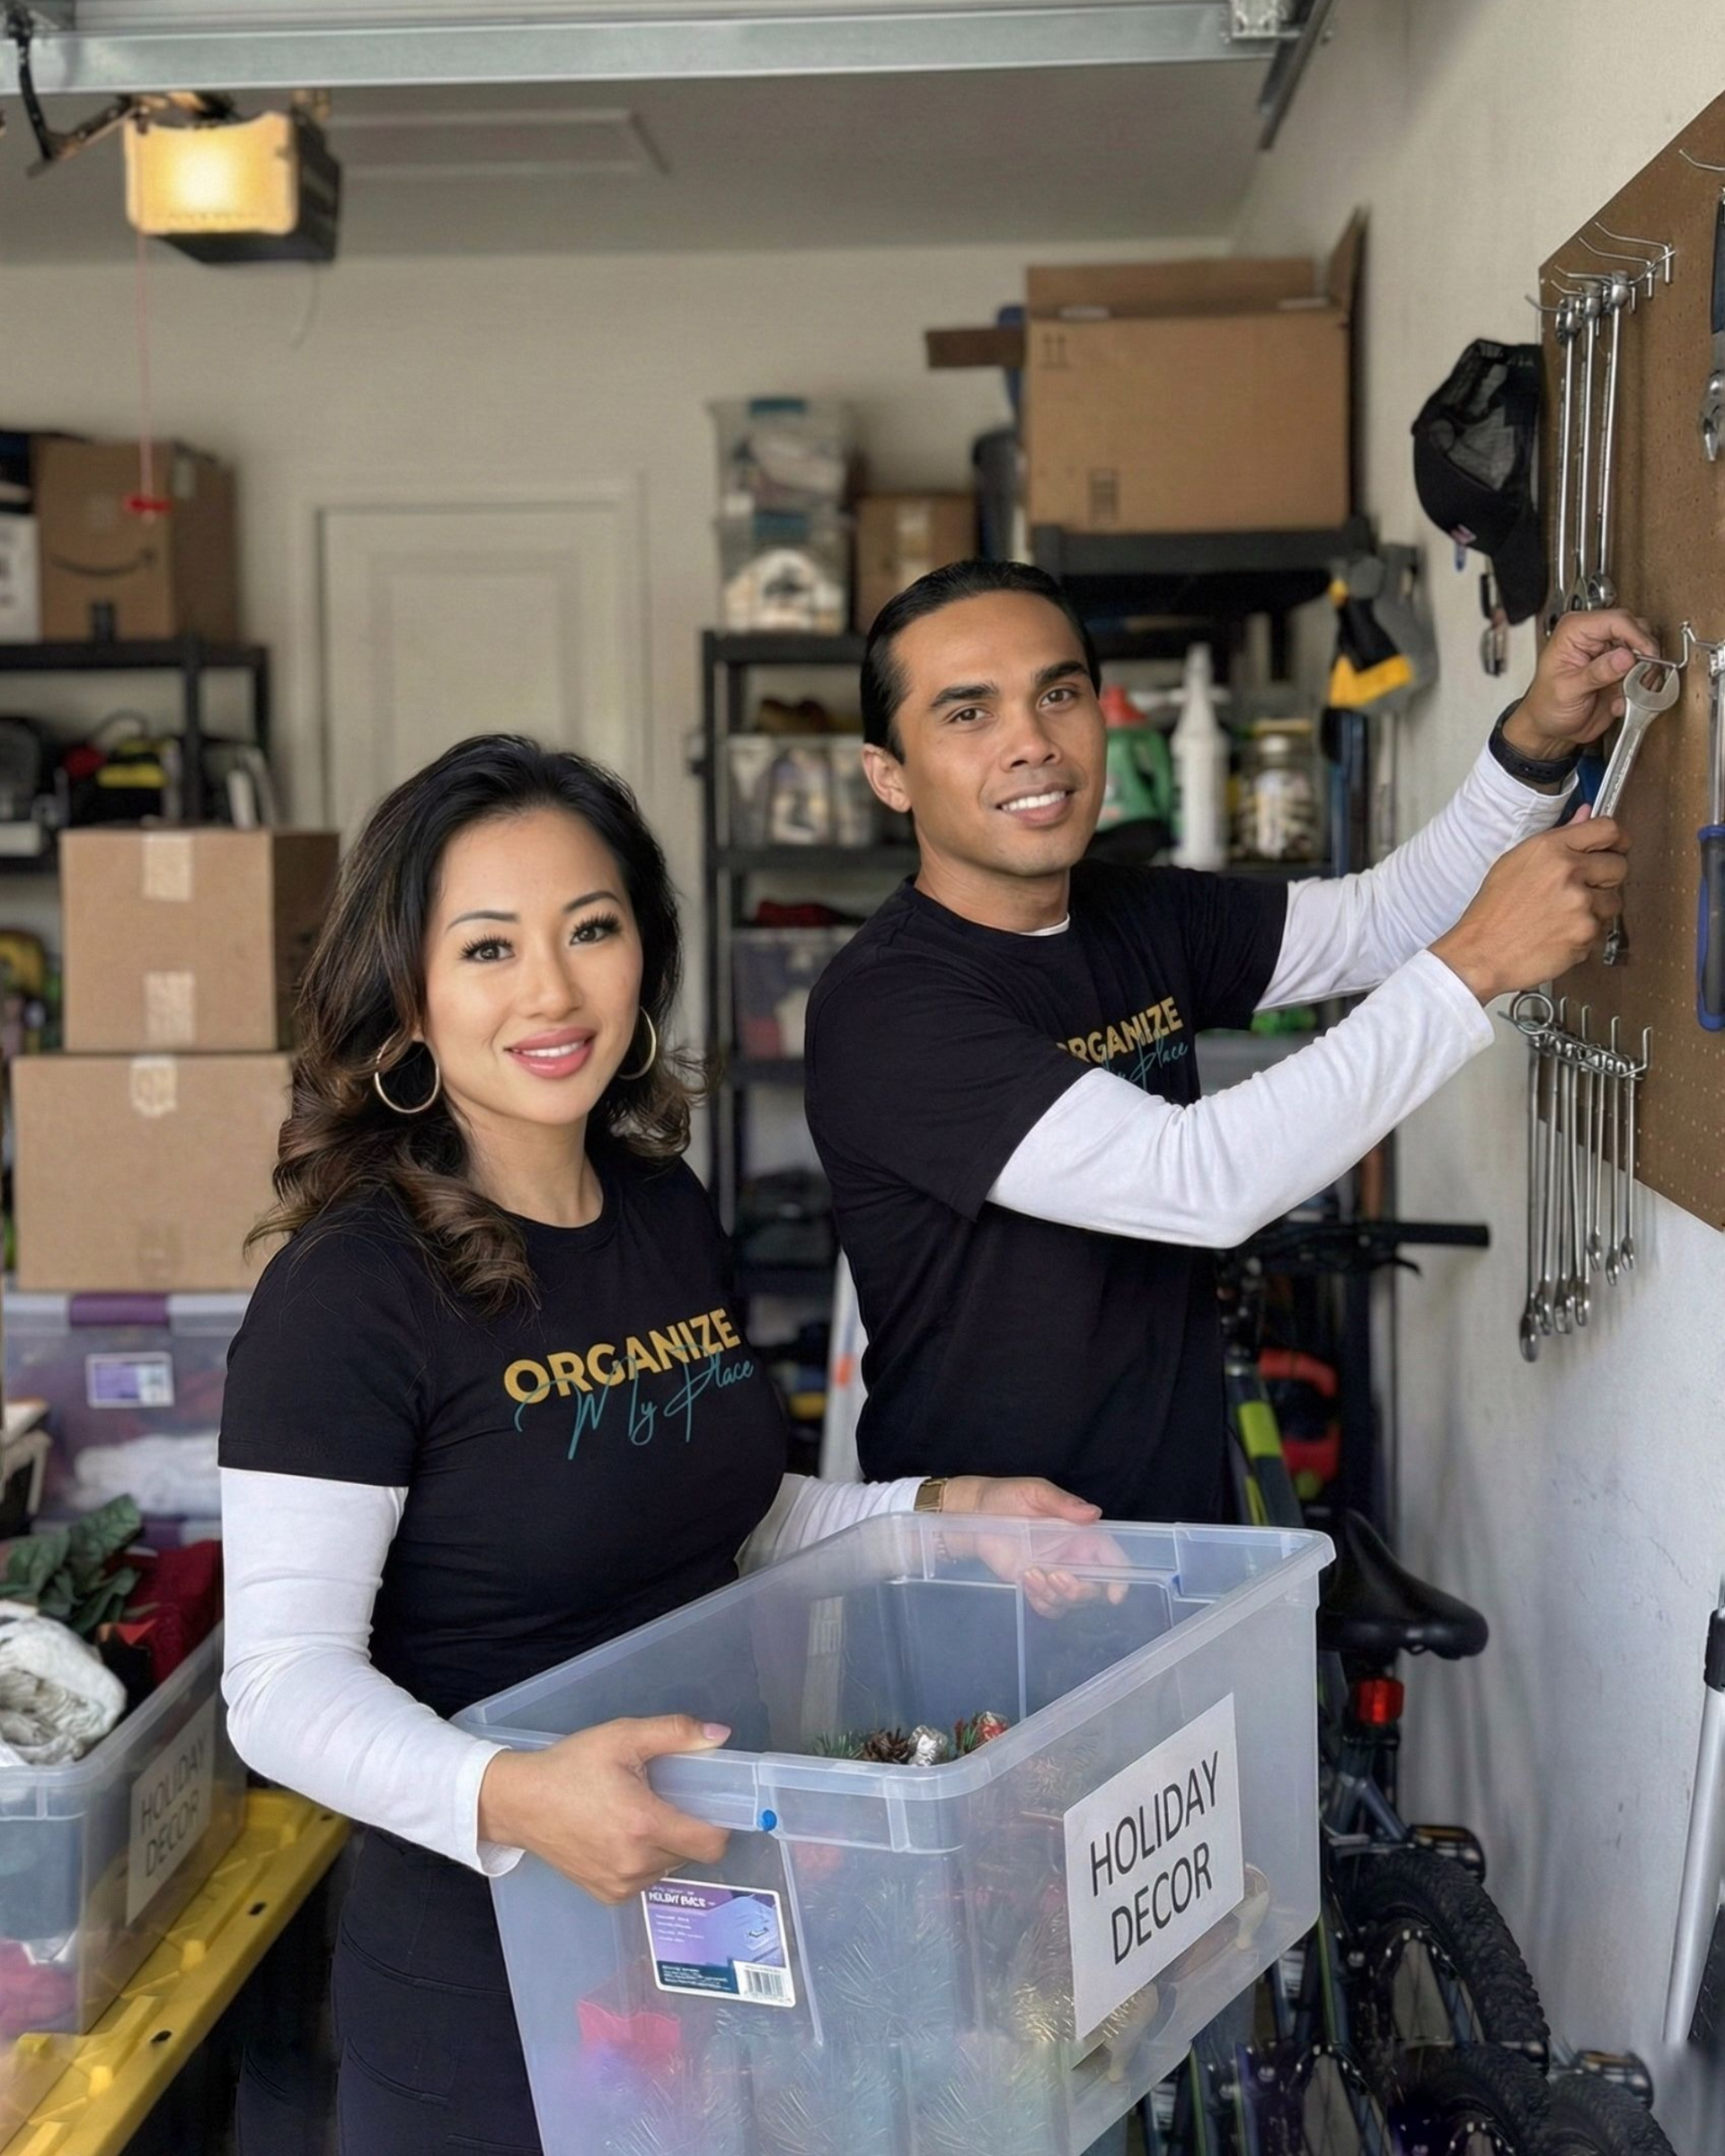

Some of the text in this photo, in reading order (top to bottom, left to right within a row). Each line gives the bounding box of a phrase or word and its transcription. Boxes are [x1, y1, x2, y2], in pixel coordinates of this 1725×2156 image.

[1056, 996, 1184, 1064] RGANIZE
[504, 1308, 741, 1404] ORGANIZE
[515, 1343, 754, 1460] My Place
[141, 1731, 207, 1835] HOLIDAY
[146, 1789, 199, 1878] DECOR
[1090, 1750, 1219, 1897] HOLIDAY
[1111, 1842, 1213, 1966] DECOR
